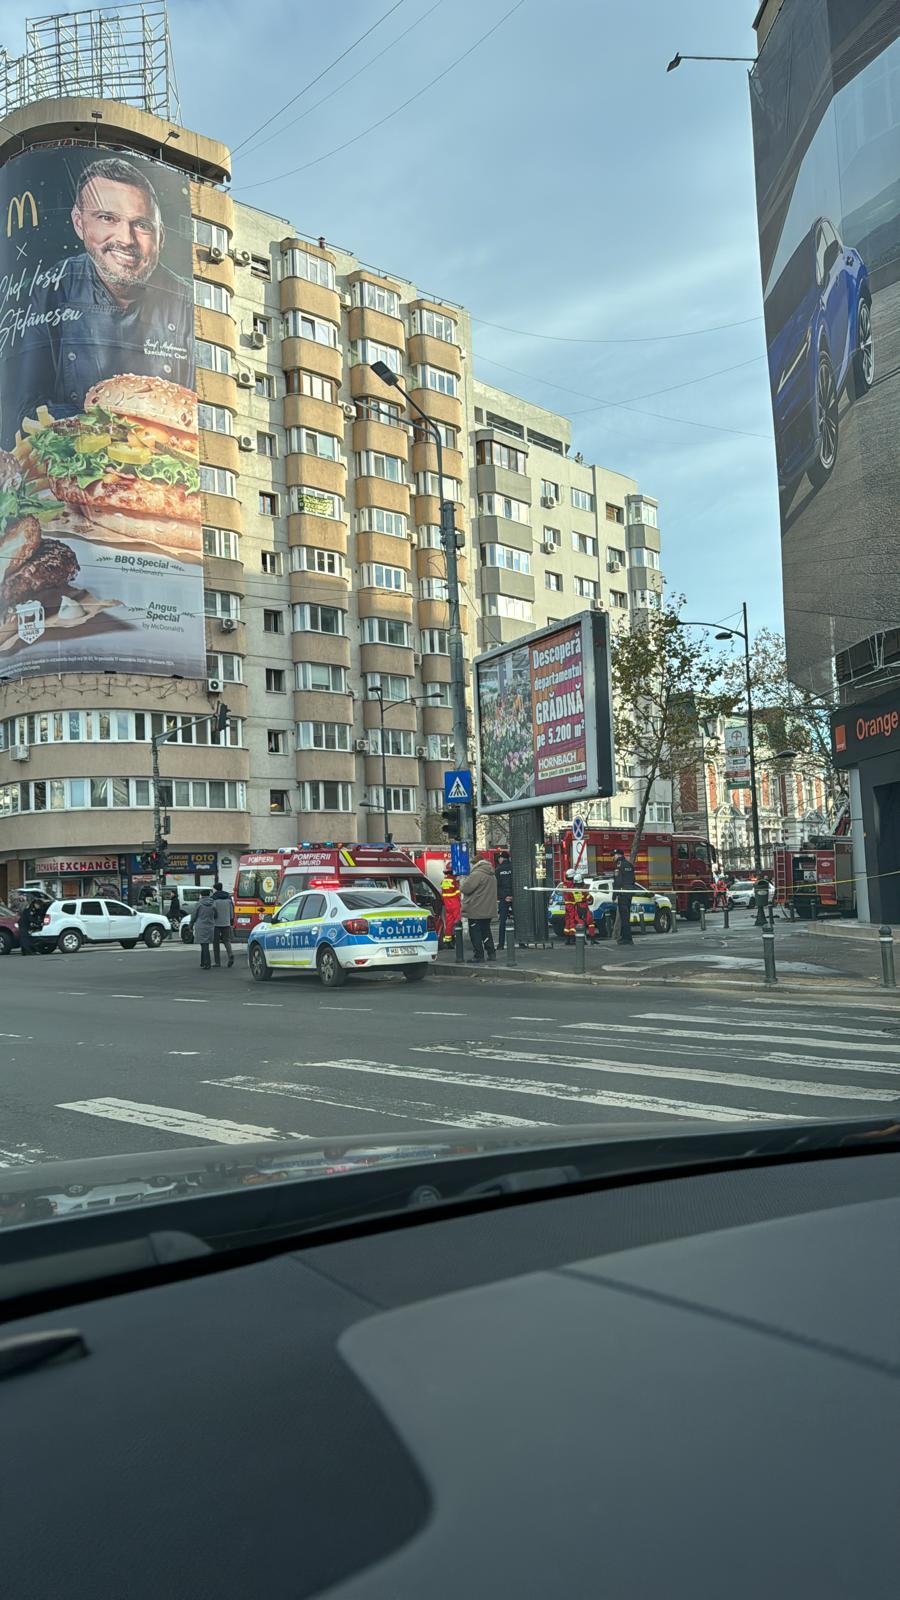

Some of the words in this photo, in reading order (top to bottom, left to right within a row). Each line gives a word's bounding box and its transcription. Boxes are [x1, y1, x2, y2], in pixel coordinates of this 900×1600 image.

[114, 555, 135, 566] BBQ
[136, 557, 169, 569] Special
[146, 611, 180, 622] Special
[148, 601, 177, 613] Angus
[142, 622, 149, 630] by
[533, 631, 581, 669] Descoperă
[535, 661, 582, 690] departamentul
[536, 682, 584, 725] GRĂDINĂ
[856, 711, 899, 740] Orange
[537, 733, 546, 751] pe
[548, 723, 571, 744] 5.200
[538, 751, 577, 770] HORNBACH
[60, 861, 117, 870] EXCHANGE
